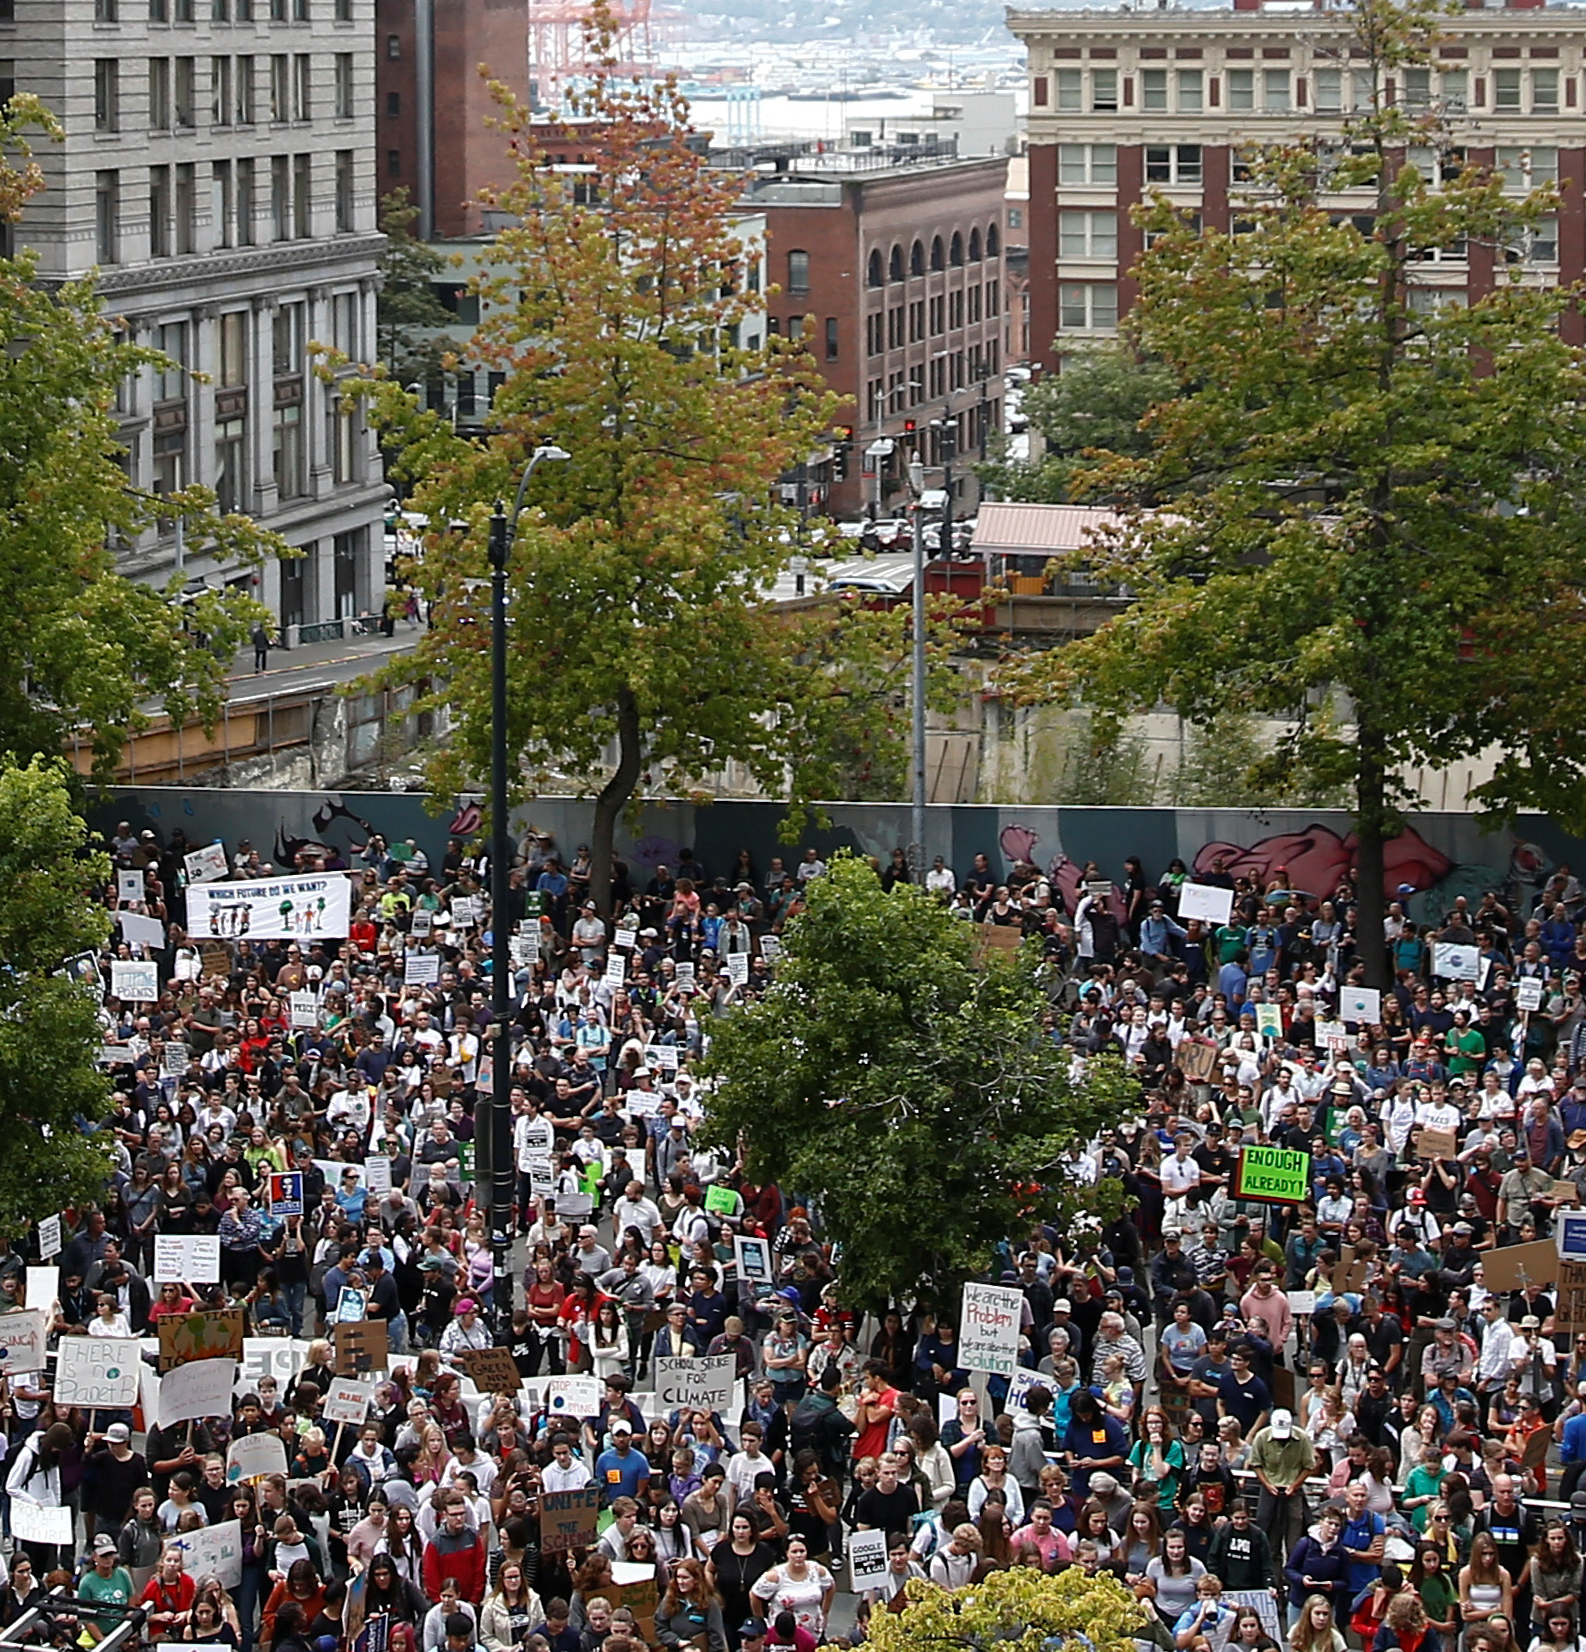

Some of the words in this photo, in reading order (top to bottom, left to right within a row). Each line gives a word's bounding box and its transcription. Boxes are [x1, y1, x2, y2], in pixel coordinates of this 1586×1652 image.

[208, 889, 235, 899] WHICH
[237, 888, 267, 898] FUTURE
[269, 887, 280, 897] DO
[283, 886, 296, 896] WE
[297, 884, 327, 895] WANT?
[117, 987, 155, 998] POINTS
[1247, 1150, 1303, 1173] ENOUGH
[1245, 1176, 1303, 1195] ALREADY!
[964, 1287, 981, 1302] We
[981, 1293, 1001, 1305] are
[1001, 1294, 1019, 1310] the
[159, 1315, 188, 1326] IT'S
[205, 1311, 238, 1322] TIME
[967, 1303, 1013, 1328] Problem
[980, 1326, 999, 1337] but
[960, 1338, 975, 1349] We
[63, 1342, 129, 1364] THERE
[471, 1361, 512, 1376] GREEN
[659, 1357, 695, 1373] SCHOOL
[696, 1356, 730, 1372] STRIKE
[963, 1349, 1014, 1374] Solution
[64, 1363, 76, 1378] IS
[486, 1374, 509, 1383] NEW
[687, 1373, 707, 1385] FOR
[1018, 1373, 1046, 1388] SAVE
[57, 1379, 117, 1403] Planet
[118, 1374, 136, 1403] B
[551, 1381, 572, 1392] STOP
[663, 1387, 728, 1406] CLIMATE
[542, 1489, 597, 1512] UNITE
[13, 1500, 65, 1521] PROTECT
[14, 1521, 67, 1541] FUTURE
[557, 1520, 579, 1534] THE
[852, 1542, 883, 1554] GOOGLE
